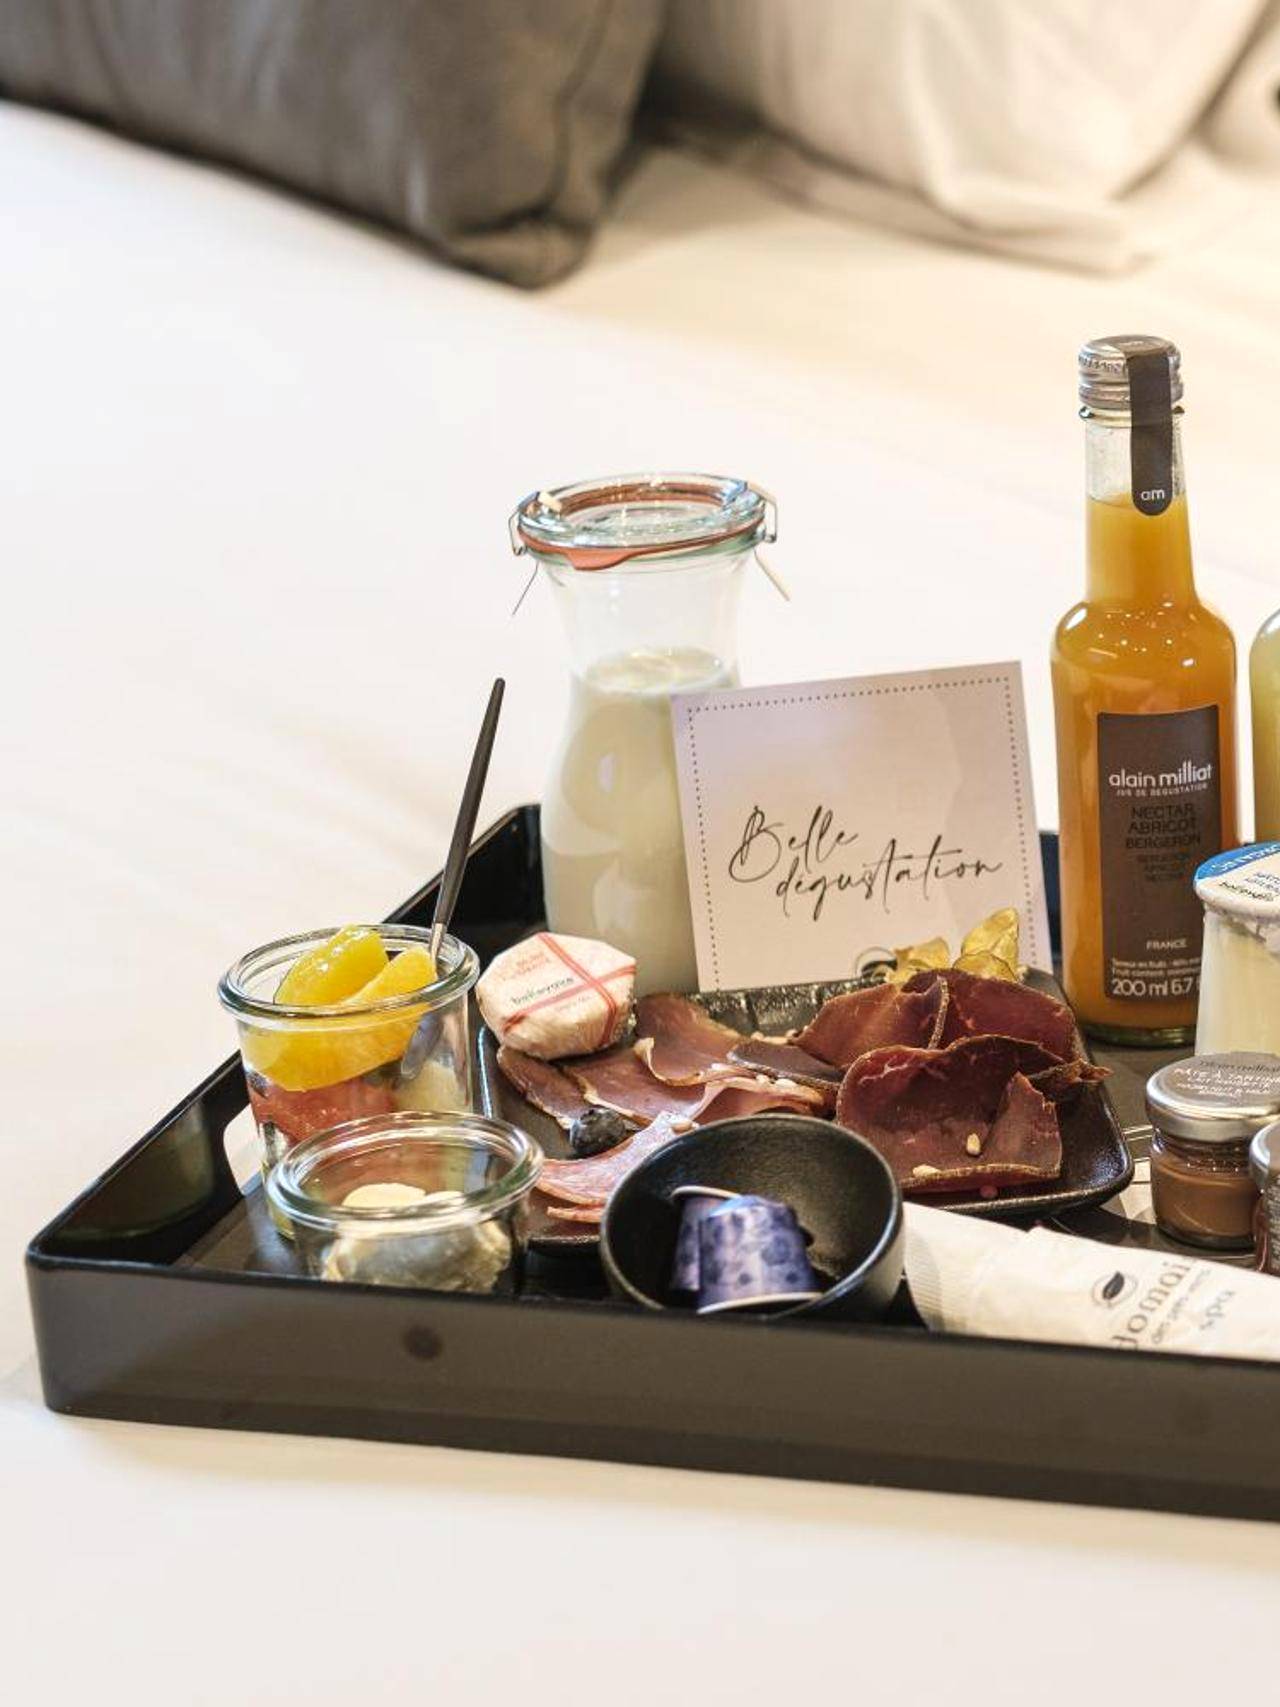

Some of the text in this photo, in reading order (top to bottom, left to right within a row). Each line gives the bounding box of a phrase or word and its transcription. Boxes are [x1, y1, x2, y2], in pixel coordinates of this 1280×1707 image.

[1141, 488, 1165, 501] am
[1108, 759, 1213, 788] alain milliat
[1135, 788, 1147, 797] DE
[1131, 803, 1194, 819] NECTAR
[1128, 817, 1198, 834] ABRICOT
[728, 805, 859, 883] Belle
[1125, 833, 1202, 849] BERGERON
[1146, 938, 1187, 951] FRANCE
[1111, 978, 1146, 996] 200
[1149, 980, 1168, 996] ml
[1111, 1258, 1196, 1350] domai
